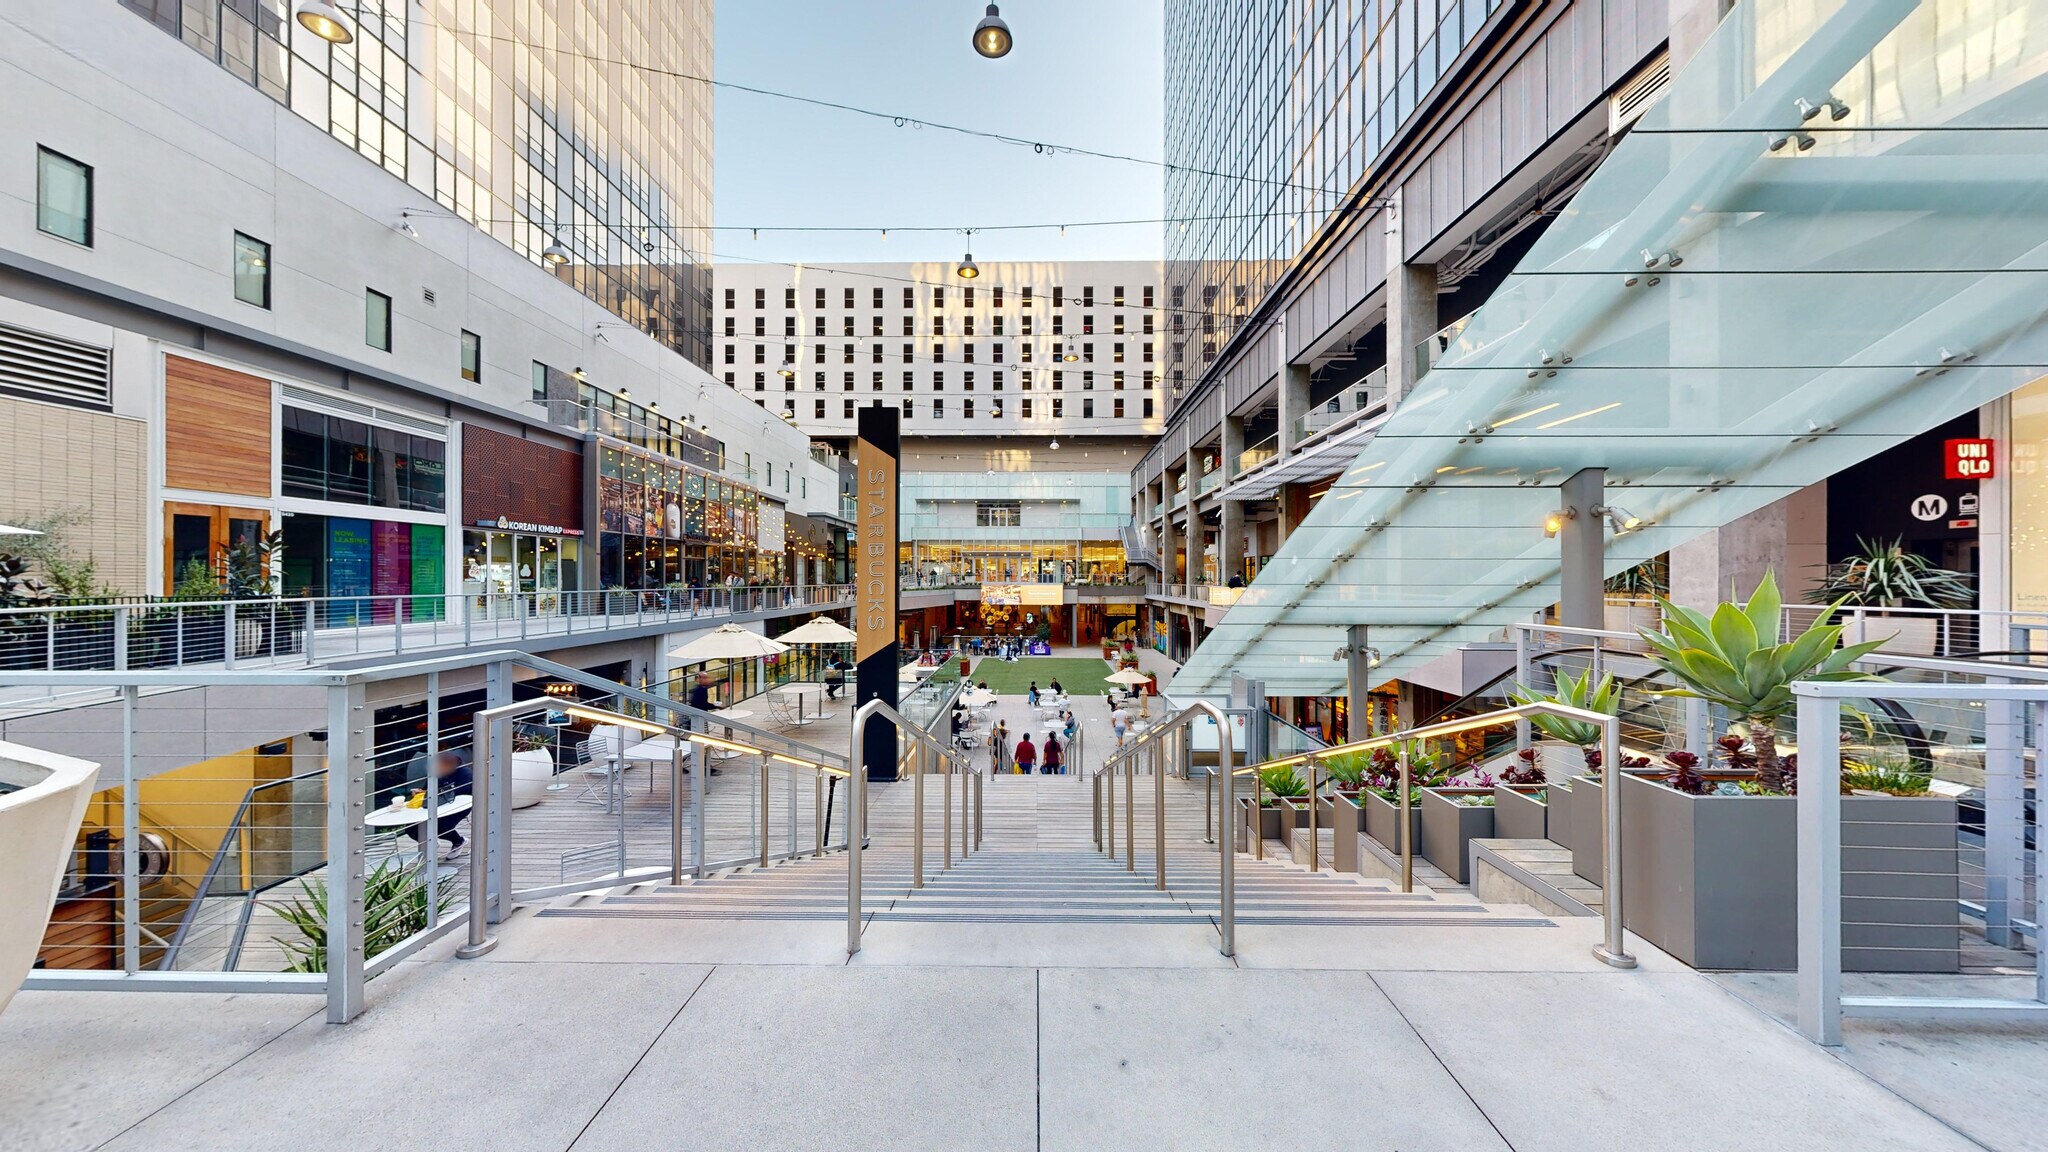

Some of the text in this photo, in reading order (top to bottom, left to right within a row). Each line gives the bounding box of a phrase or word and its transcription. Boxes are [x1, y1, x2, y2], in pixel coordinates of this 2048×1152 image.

[1957, 443, 1987, 458] UNI
[1958, 459, 1990, 476] QLO
[1918, 499, 1940, 516] M
[508, 520, 538, 532] KOREAN
[538, 524, 563, 535] KIMBAP
[867, 469, 886, 631] STARBUCKS
